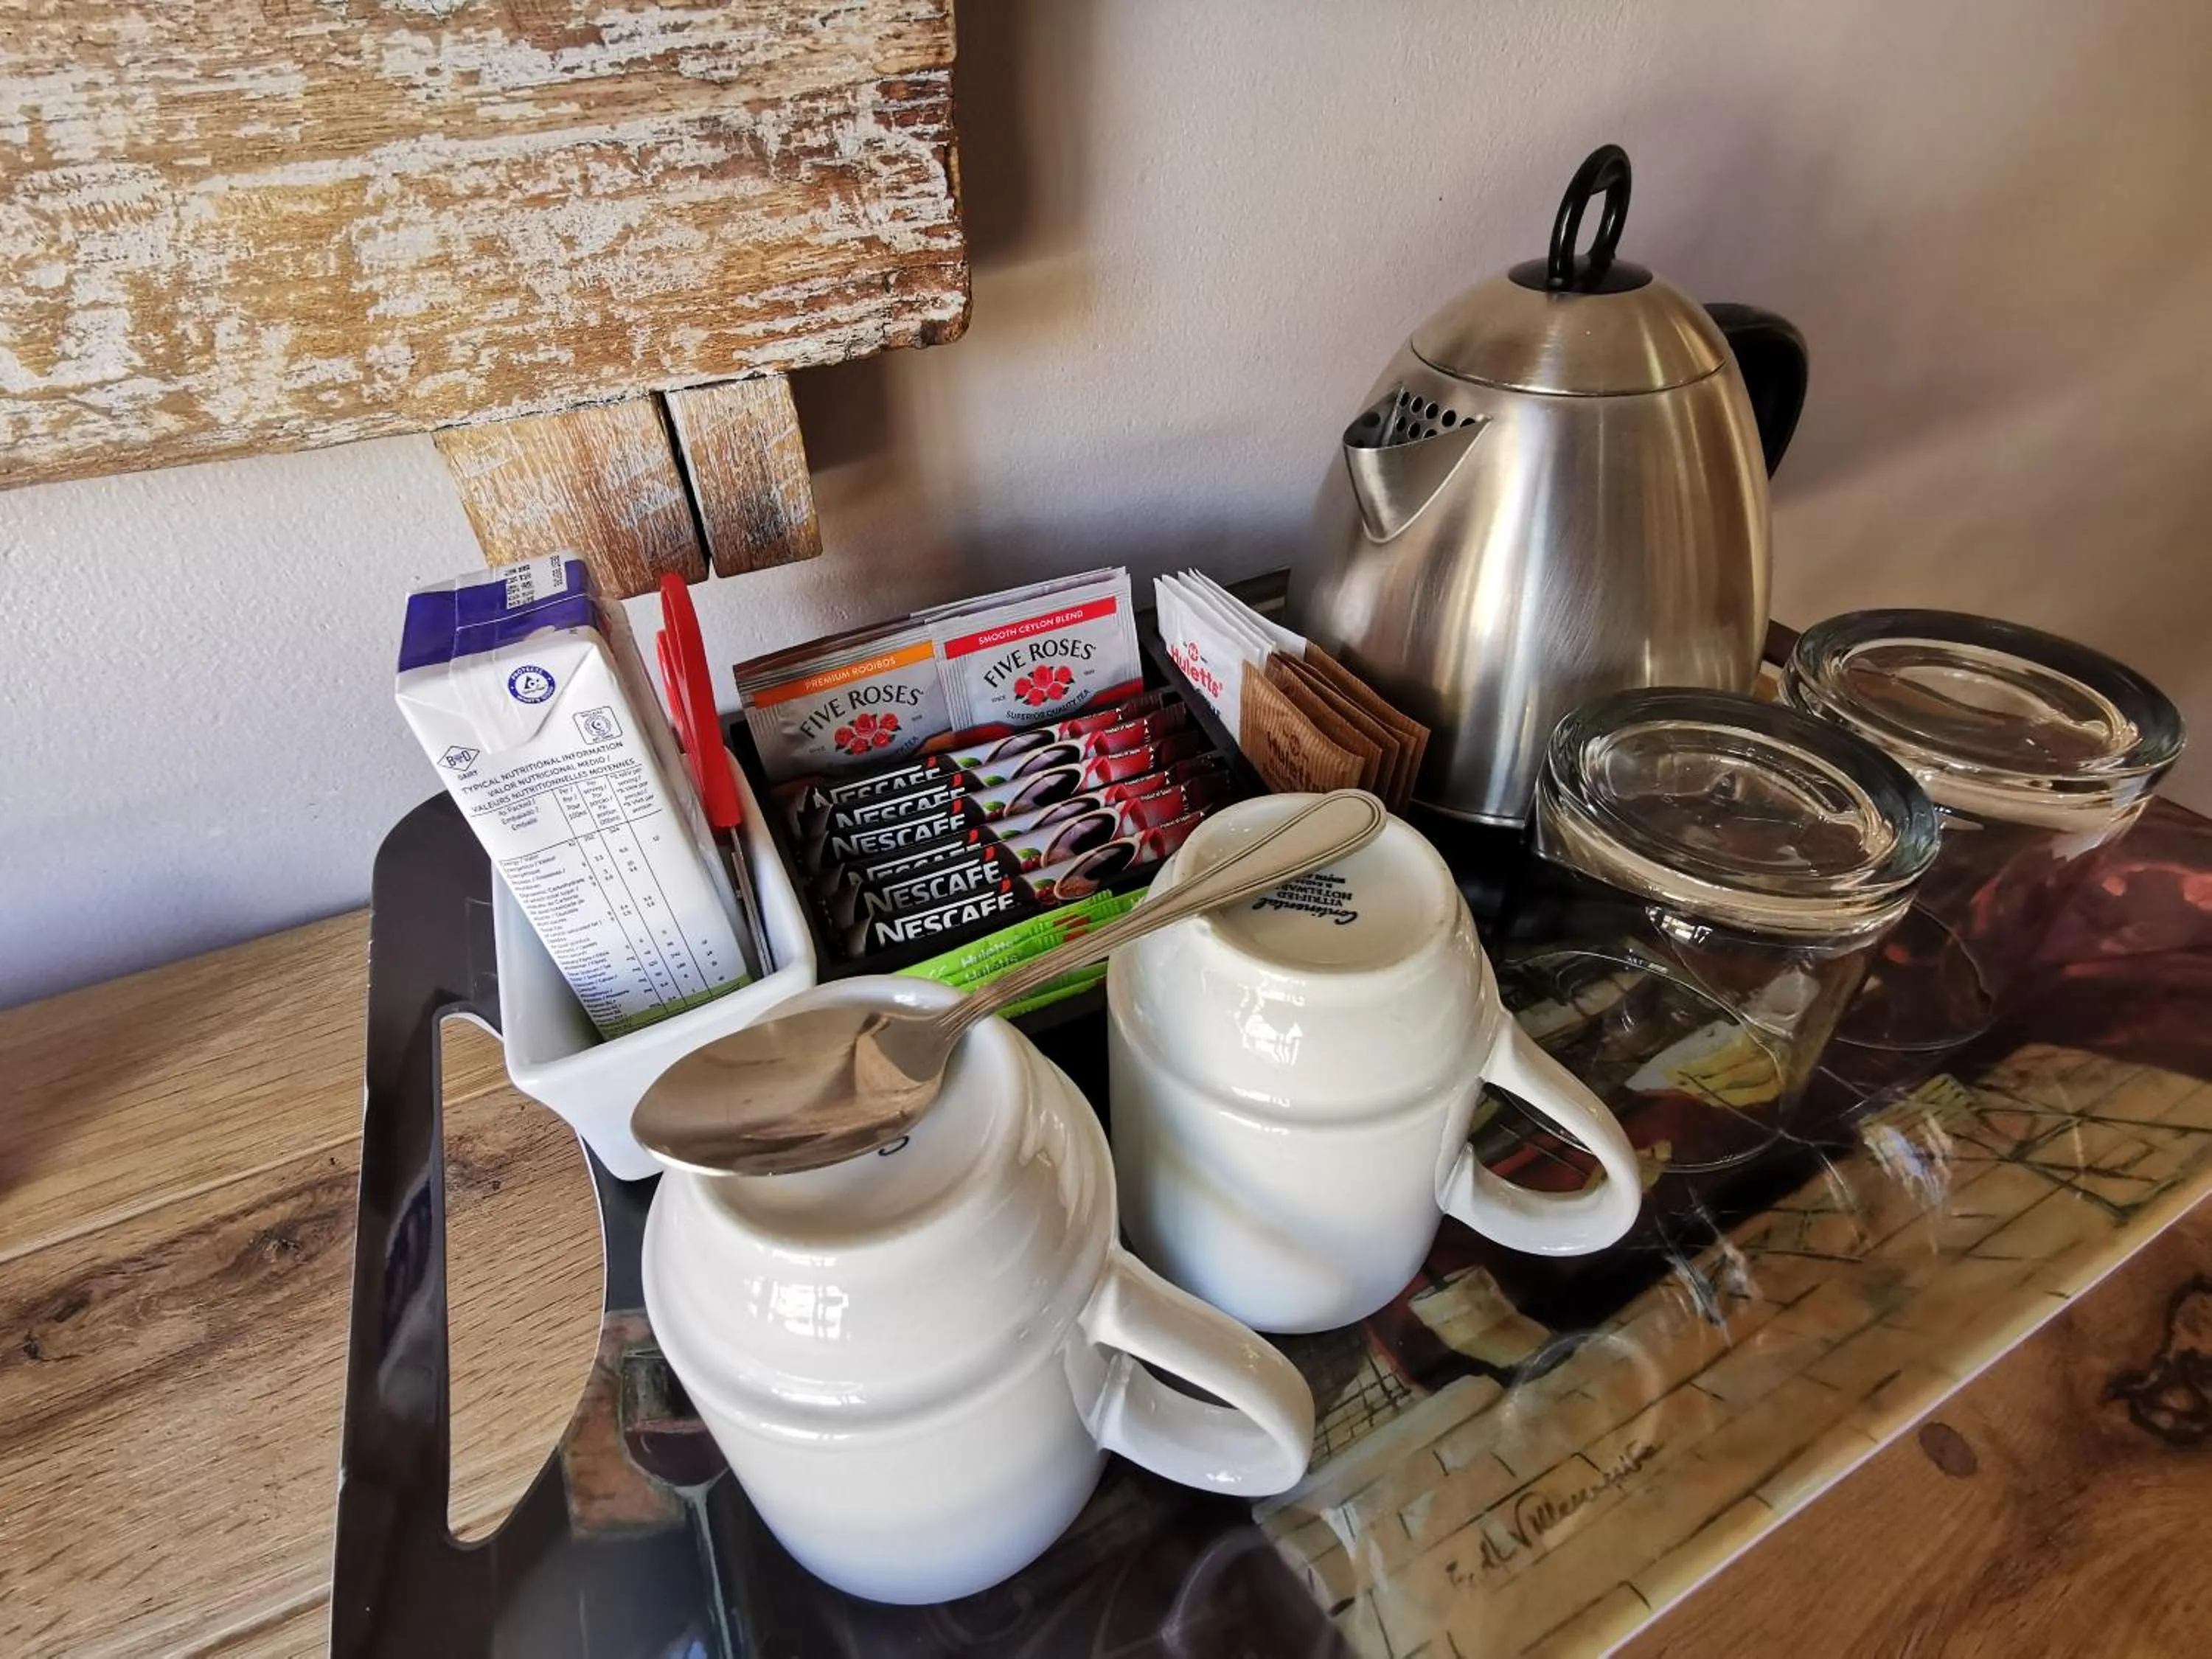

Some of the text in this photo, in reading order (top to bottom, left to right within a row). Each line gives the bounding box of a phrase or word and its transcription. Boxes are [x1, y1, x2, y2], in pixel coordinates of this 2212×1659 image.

[978, 610, 1083, 645] SMOOTH CEYLON BLEND
[804, 655, 897, 691] PREMIUM ROOIBOS
[983, 638, 1095, 688] FIVE ROSES
[800, 684, 923, 740] FIVE ROSES
[1077, 688, 1090, 701] TEA
[461, 741, 623, 795] TYPICAL NUTRITIONAL INFORMATION
[471, 795, 512, 812] VALEURS
[512, 771, 588, 799] NUTRITIONNELLES
[589, 757, 636, 775] MOYENNES
[487, 781, 518, 797] VALOR
[518, 763, 577, 786] NUTRICIONAL
[1275, 884, 1353, 901] HOTELWAR
[1276, 891, 1343, 907] VITRIFIED
[1251, 897, 1359, 925] Continental
